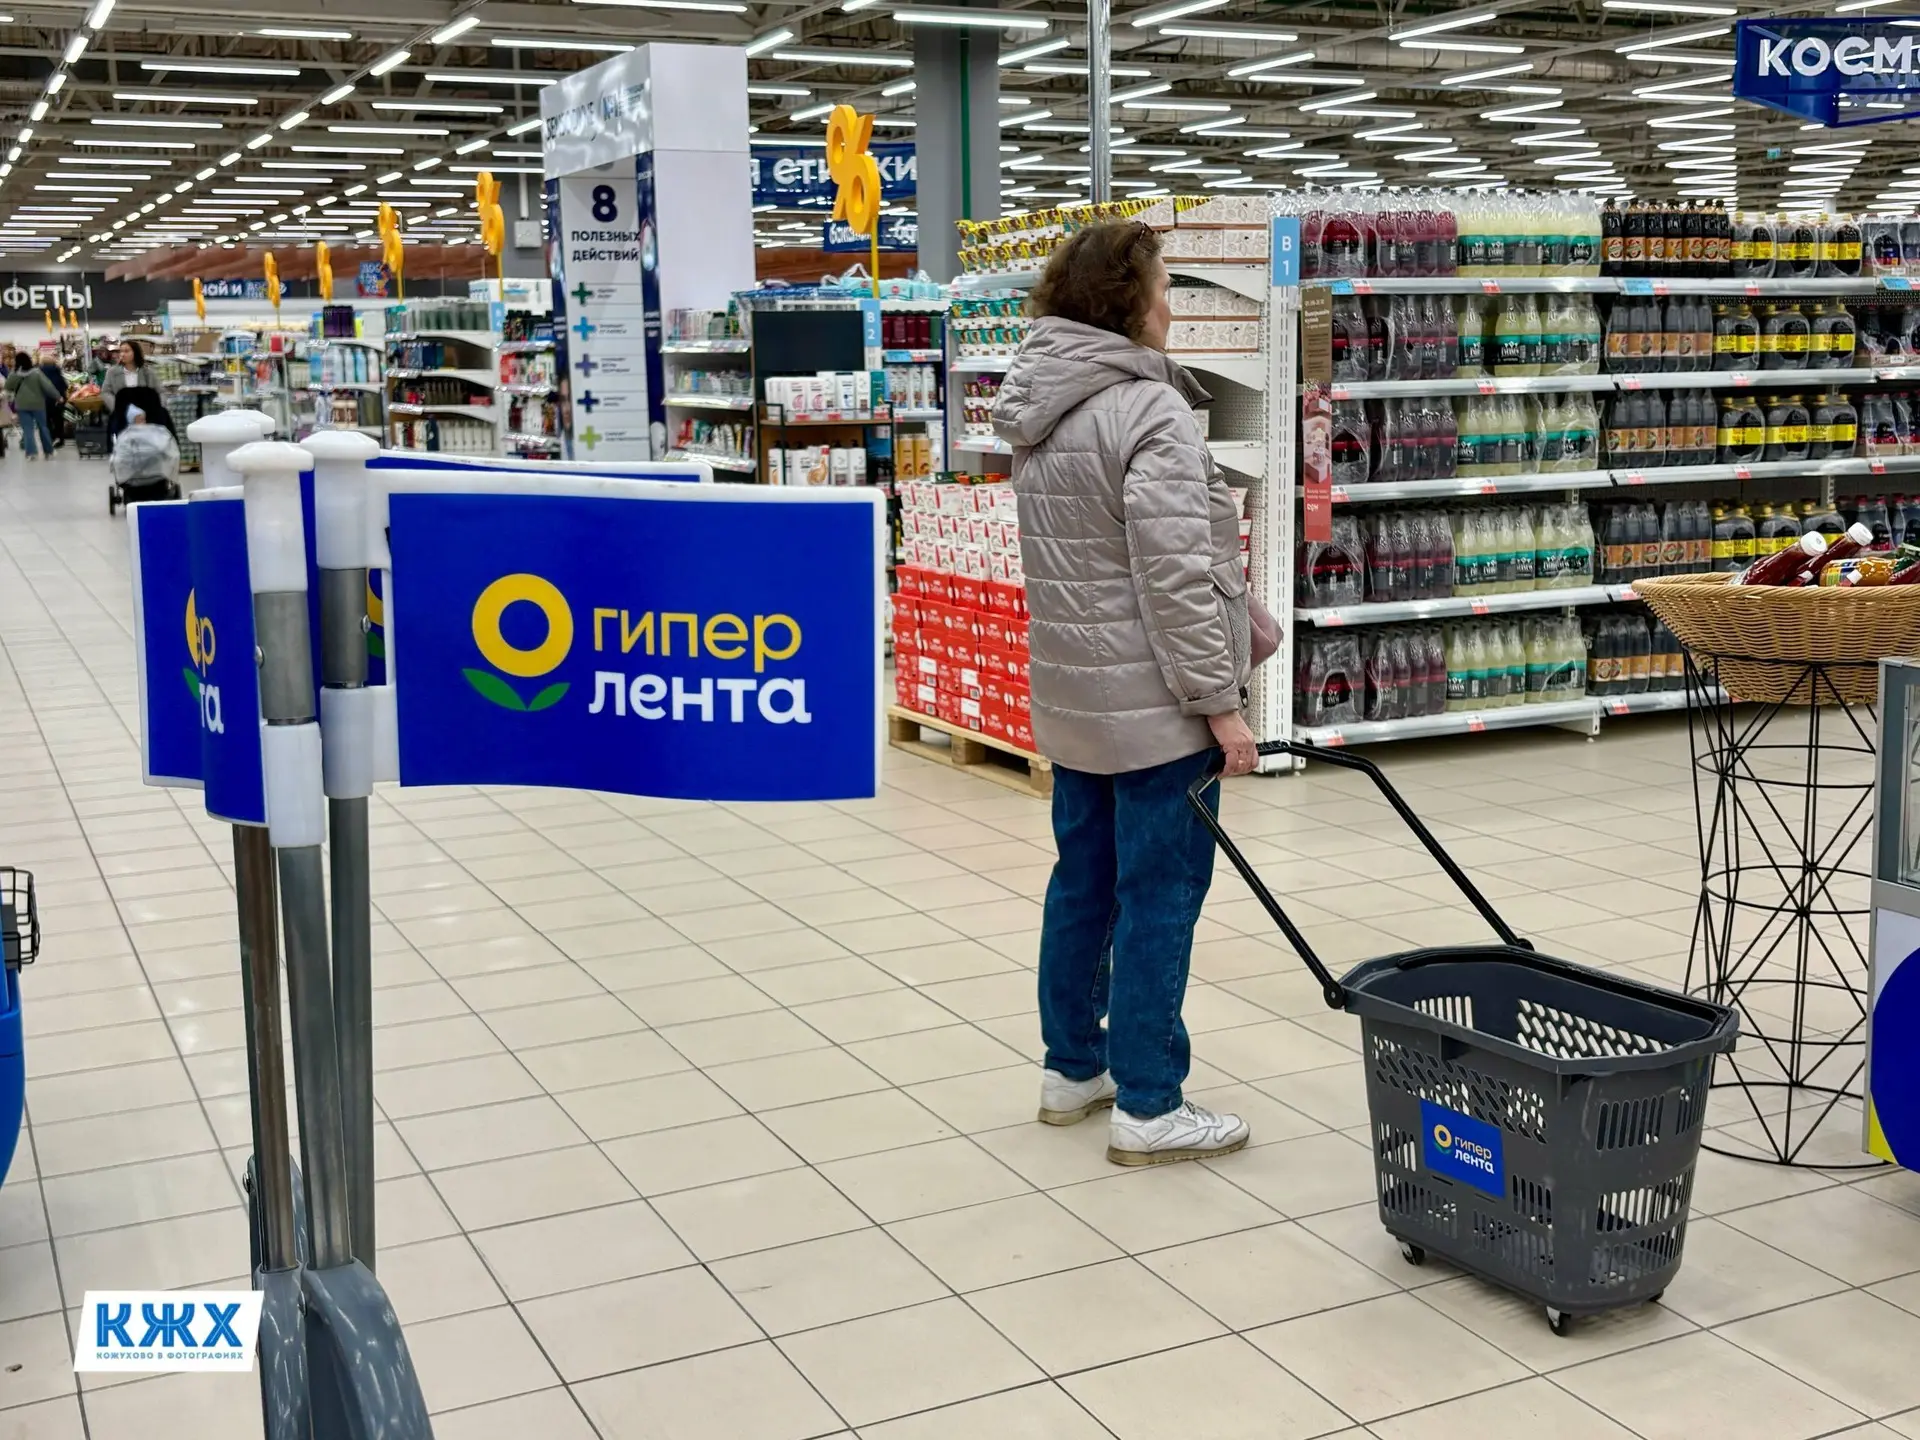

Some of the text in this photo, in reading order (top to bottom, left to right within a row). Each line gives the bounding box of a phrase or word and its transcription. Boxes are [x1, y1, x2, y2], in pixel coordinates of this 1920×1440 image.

[592, 184, 618, 223] 8
[571, 230, 641, 242] ПОЛЕЗНЫХ
[572, 247, 640, 262] ДЕЙСТВИЙ
[1282, 260, 1290, 276] 1
[0, 284, 93, 310] ФЕТЫ
[867, 328, 876, 340] 2
[592, 607, 803, 673] гипер
[588, 670, 812, 725] лента
[1455, 1136, 1491, 1160] гипер
[1455, 1150, 1494, 1174] лента
